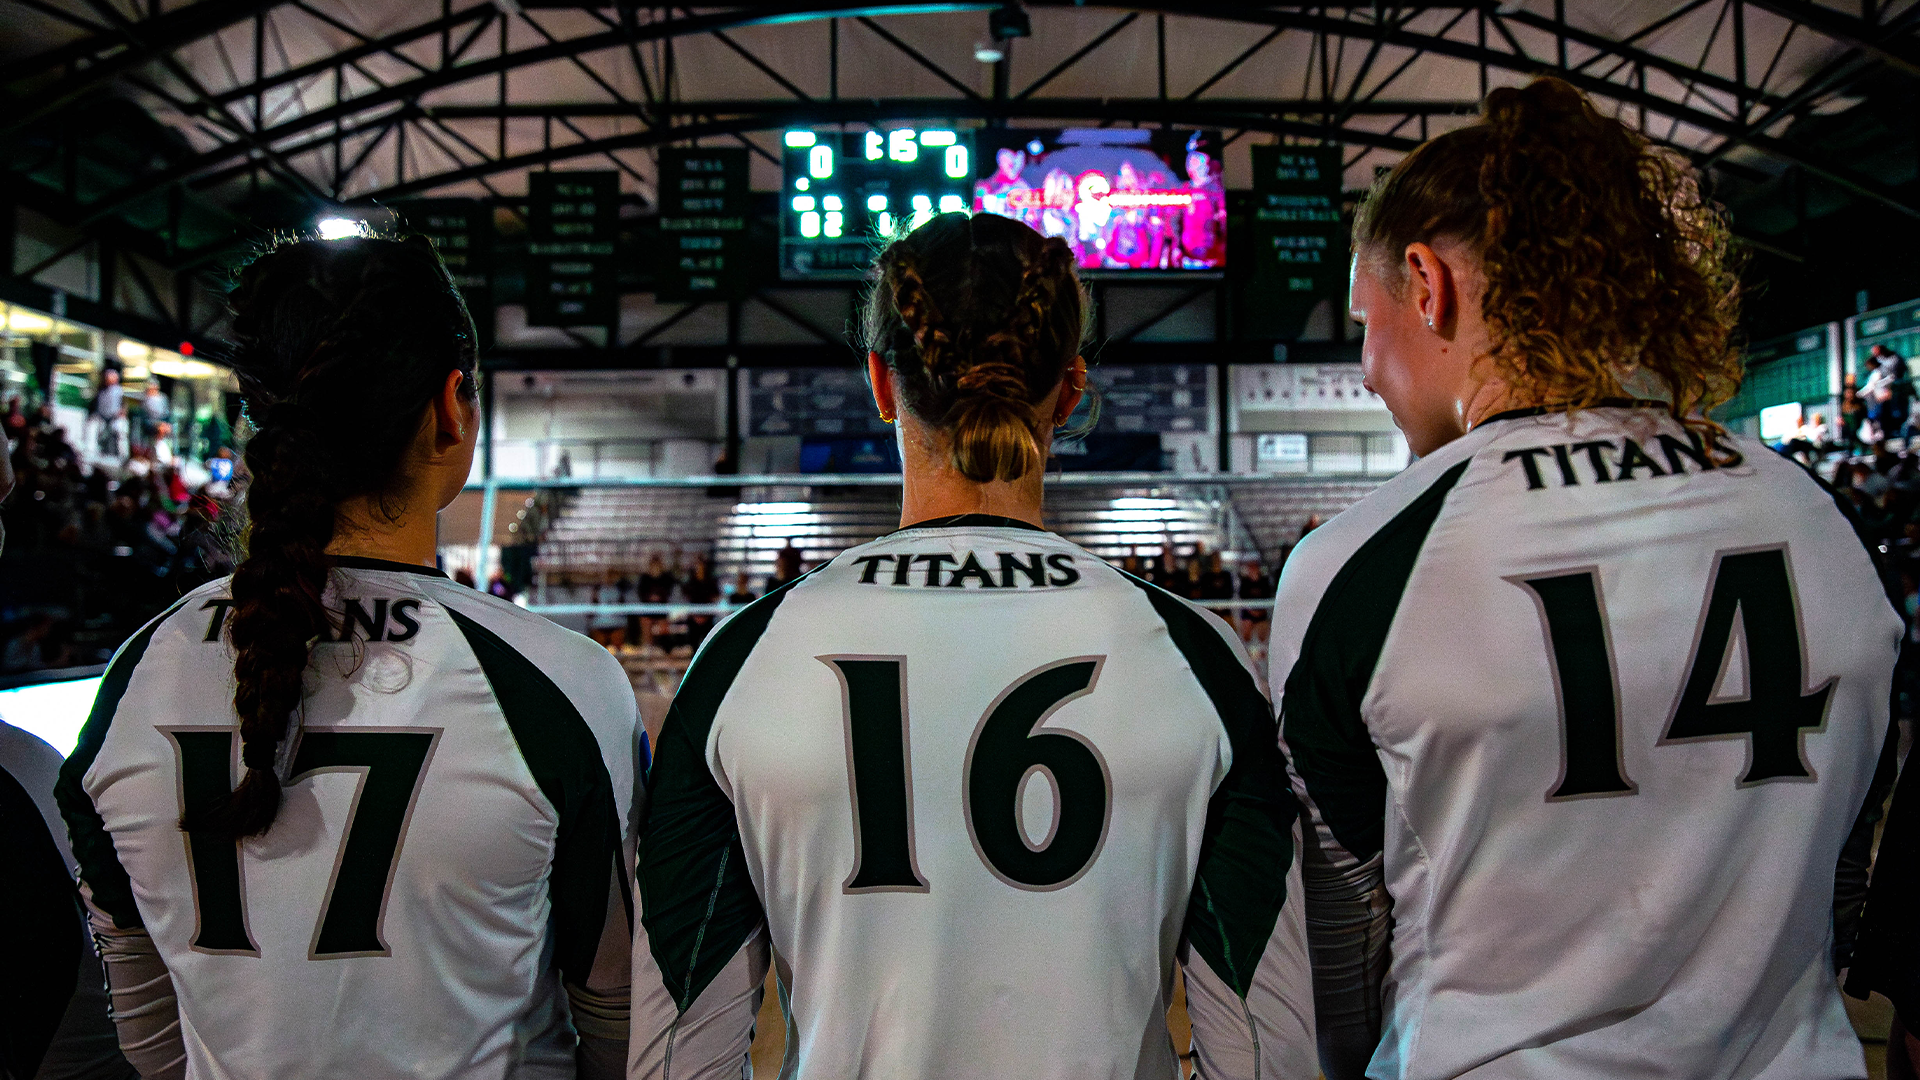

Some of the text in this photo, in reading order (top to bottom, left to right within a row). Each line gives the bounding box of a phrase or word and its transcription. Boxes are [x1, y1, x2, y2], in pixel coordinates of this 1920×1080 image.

[810, 145, 832, 178] 0
[945, 145, 968, 178] 0
[851, 550, 1080, 589] TITANS
[198, 598, 422, 643] TNS
[1500, 541, 1841, 803] 14
[814, 653, 1113, 894] 16
[154, 725, 444, 960] 17
